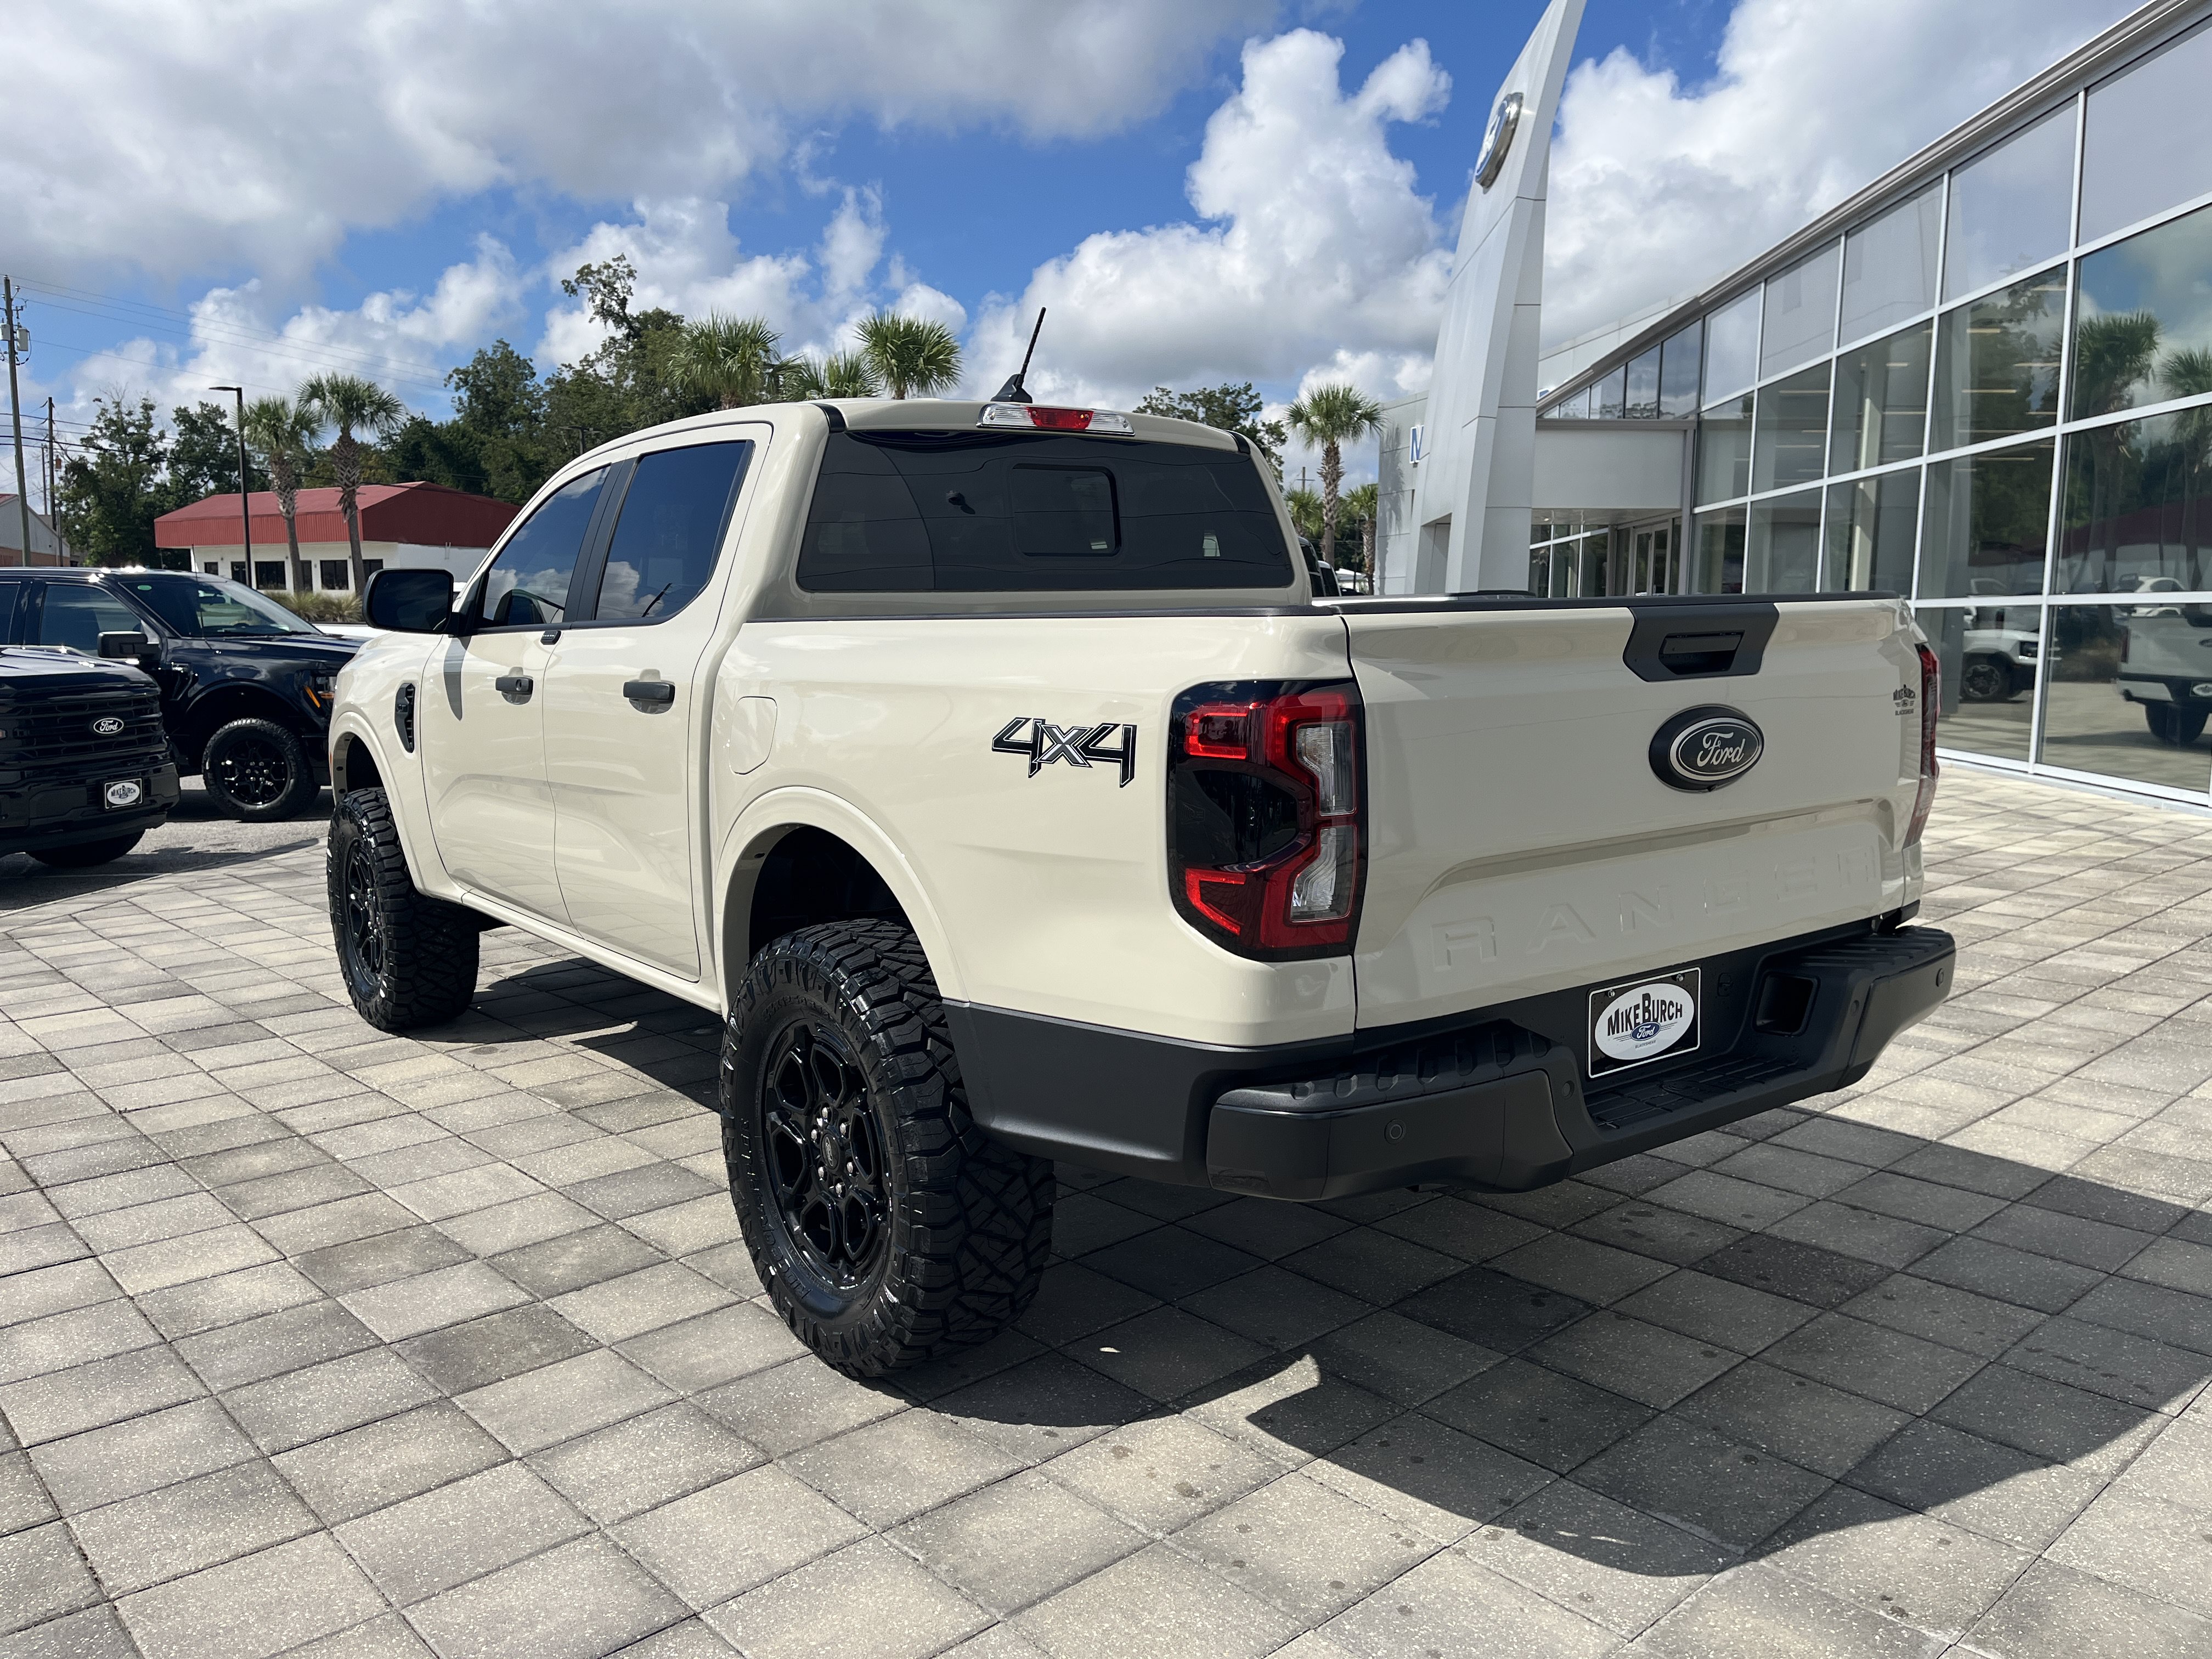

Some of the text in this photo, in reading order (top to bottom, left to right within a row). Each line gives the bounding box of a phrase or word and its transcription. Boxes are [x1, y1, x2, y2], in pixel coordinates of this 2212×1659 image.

[100, 720, 118, 731] Ford
[1697, 732, 1746, 767] Ford
[1431, 844, 1878, 972] RANGER
[1607, 992, 1683, 1036] MIKE BURCH
[1635, 1040, 1656, 1048] BLACKSHEAR
[1637, 1025, 1655, 1039] Ford
